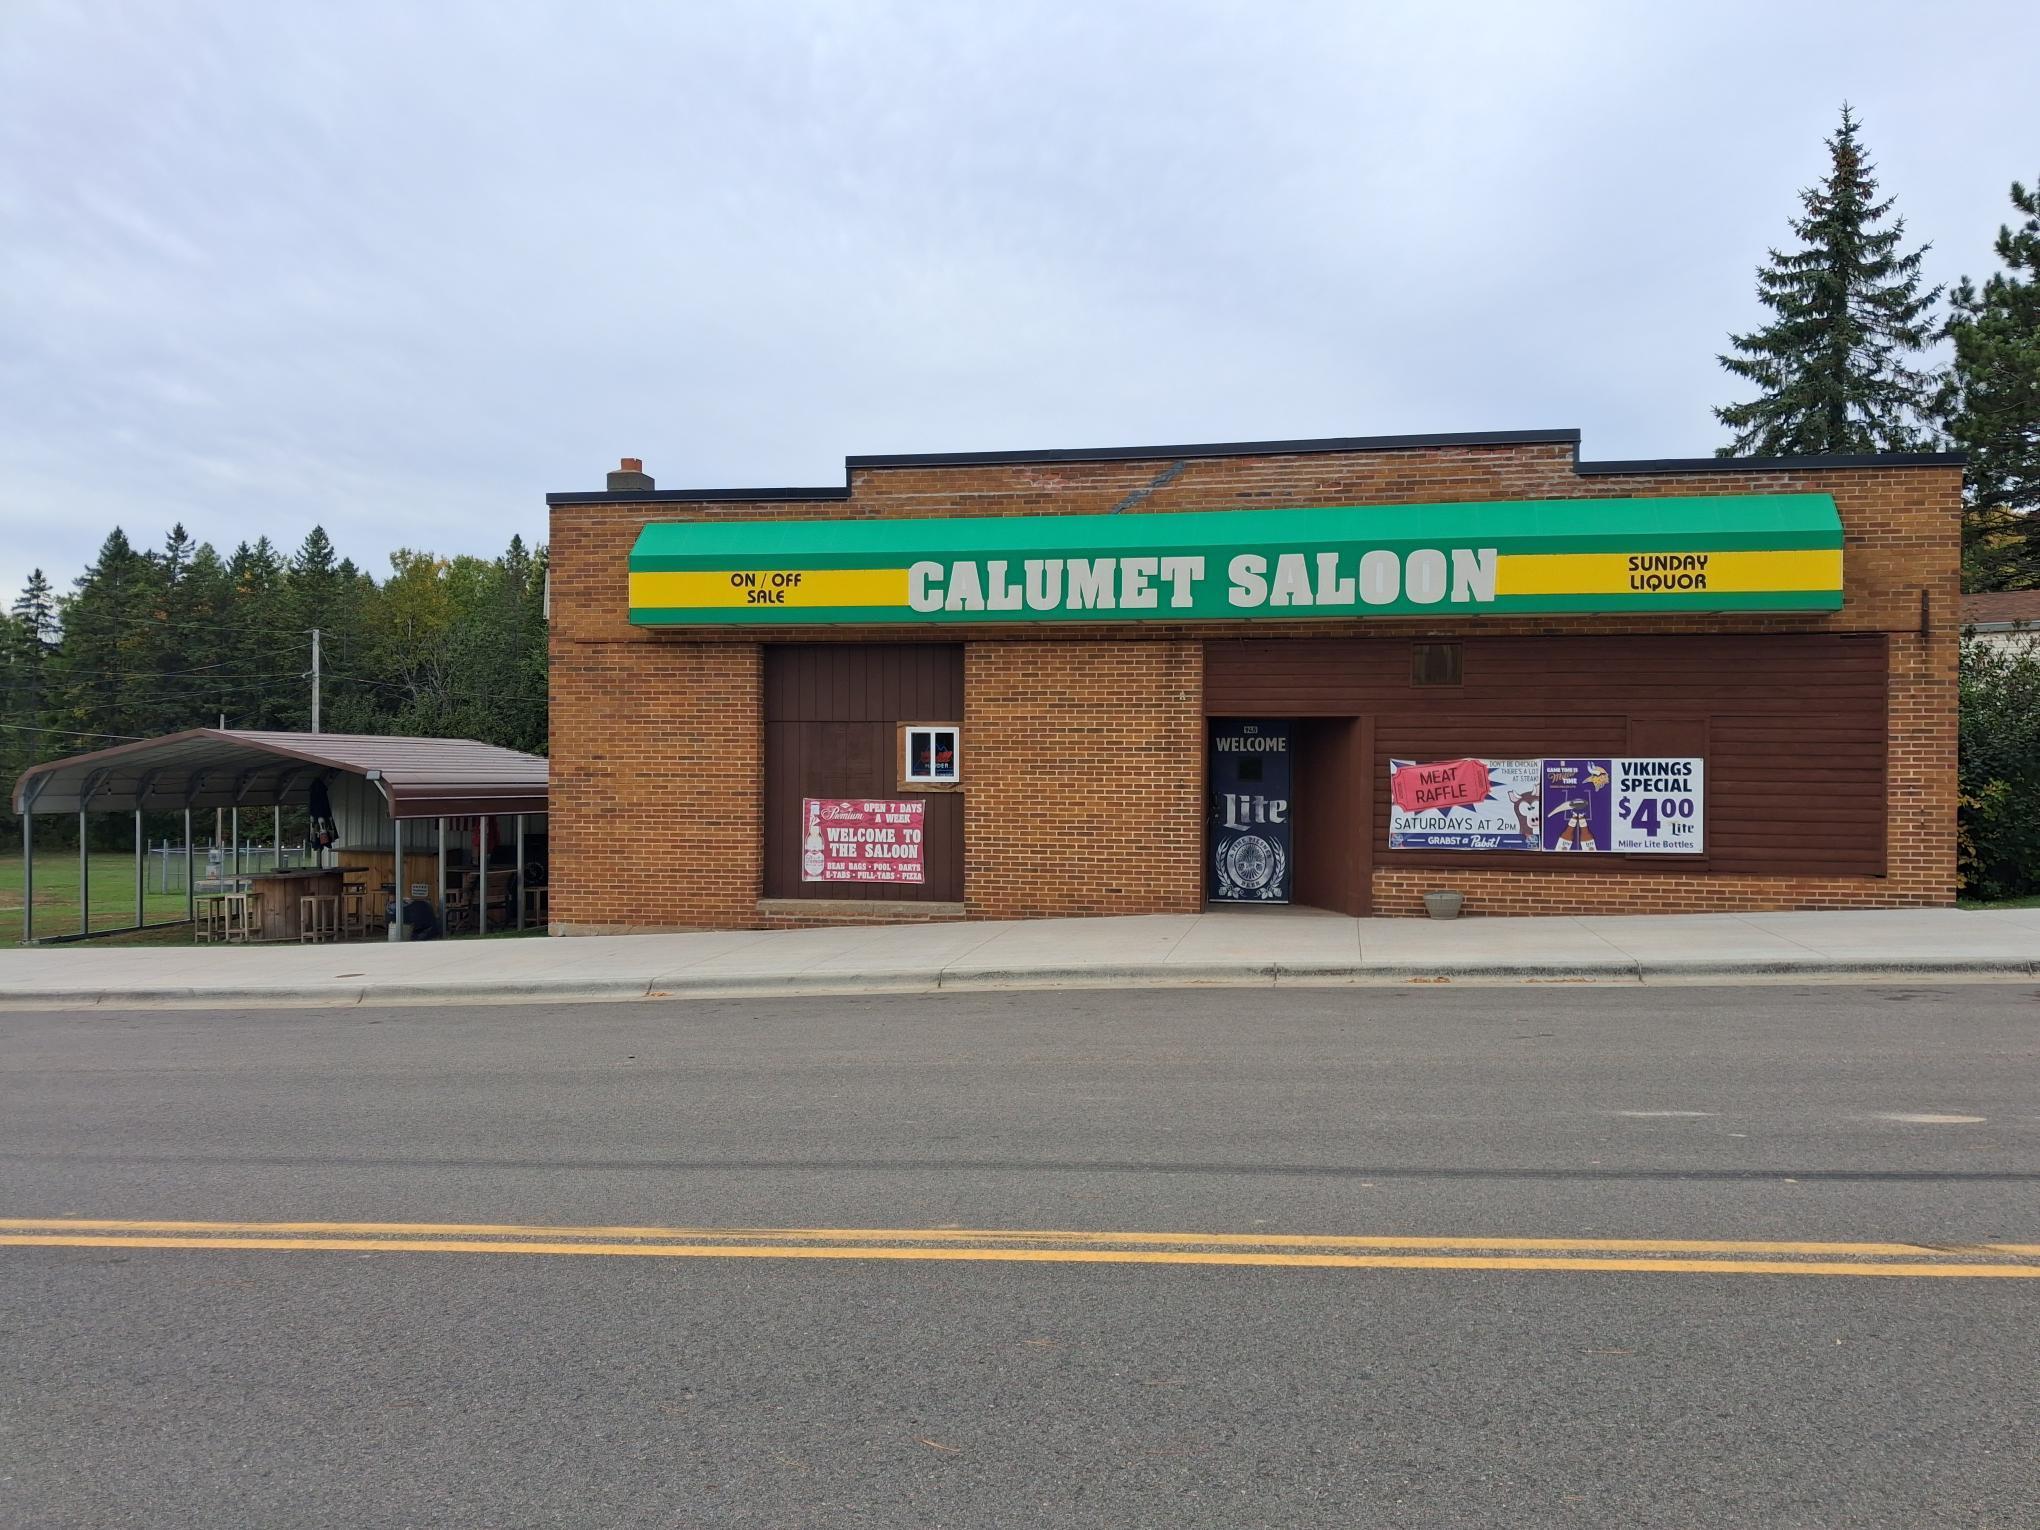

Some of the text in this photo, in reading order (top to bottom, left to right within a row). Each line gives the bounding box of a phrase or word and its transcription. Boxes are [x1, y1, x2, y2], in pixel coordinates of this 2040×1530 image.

[1628, 555, 1709, 572] SUNDAY
[730, 573, 757, 587] ON
[771, 573, 801, 587] OFF
[909, 548, 1498, 613] CALUMET SALOON
[1629, 573, 1707, 591] LIQUOR
[747, 589, 785, 603] SALE
[1216, 737, 1287, 752] WELCOME
[1419, 767, 1458, 785] MEAT
[1620, 762, 1692, 776] VIKINGS
[1620, 779, 1692, 793] SPECIAL
[1415, 783, 1468, 804] RAFFLE
[821, 805, 865, 821] Premium
[864, 803, 922, 813] OPEN 7 DAYS
[1223, 793, 1288, 831] Lite
[875, 814, 911, 823] A WEEK
[1394, 817, 1516, 831] SATURDAYS AT 2PM
[826, 828, 921, 843] WELCOME TO
[1670, 823, 1694, 836] Lite
[1233, 839, 1246, 851] FINE
[1428, 836, 1461, 845] GRABST
[1470, 834, 1500, 848] Pabst!
[1618, 840, 1694, 849] Miller Lite Bottles
[829, 843, 918, 859] THE SALOON
[827, 862, 921, 872] BEAN BAGS POOL DARTS
[825, 871, 922, 880] E-TABS PULL-TABS PIZZA
